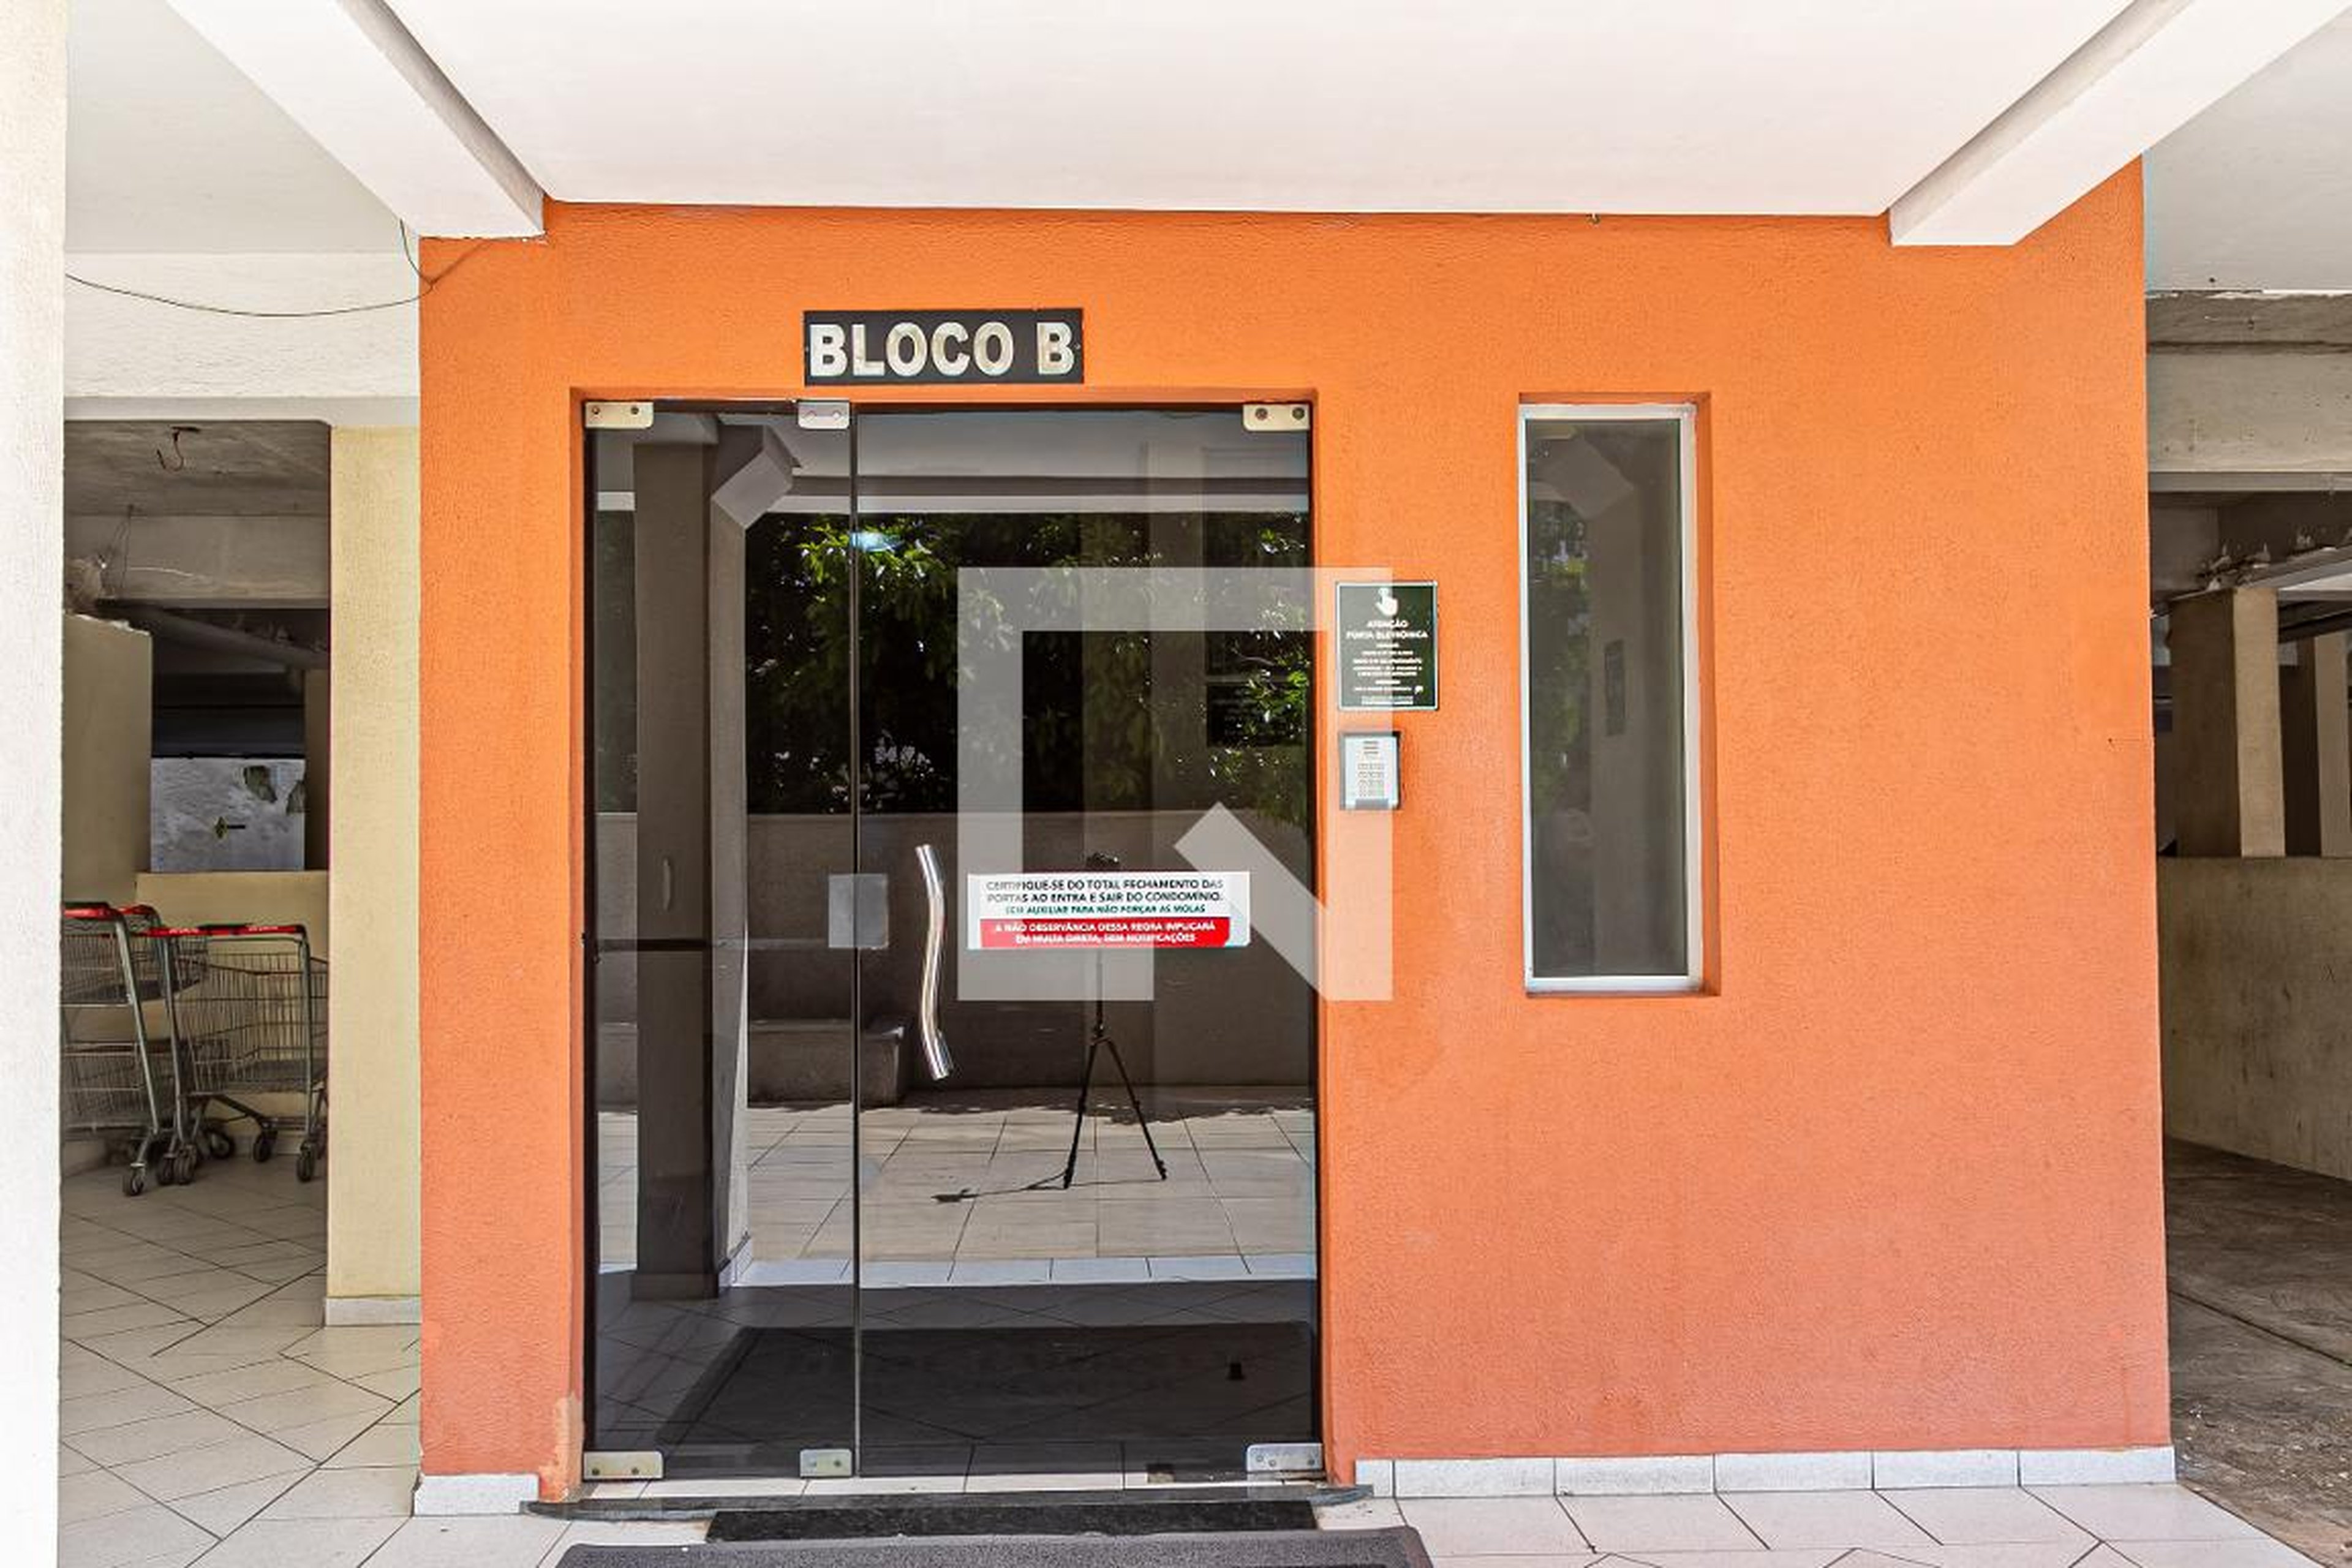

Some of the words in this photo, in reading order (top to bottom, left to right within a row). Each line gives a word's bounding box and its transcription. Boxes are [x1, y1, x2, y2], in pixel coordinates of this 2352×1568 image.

[810, 322, 1014, 376] BLOCO
[1037, 322, 1074, 375] B
[986, 880, 1065, 891] CERTIFIQUE-SE
[1067, 880, 1085, 891] DO
[1087, 880, 1120, 890] TOTAL
[1123, 879, 1199, 889] FECHAMENTO
[1202, 879, 1223, 889] DAS
[987, 893, 1029, 903] PORTAS
[1031, 893, 1048, 902] AO
[1050, 893, 1087, 902] ENTRA
[1090, 892, 1096, 902] E
[1098, 892, 1124, 902] SAIR
[1126, 892, 1144, 902] DO
[1096, 904, 1119, 913] NÃO
